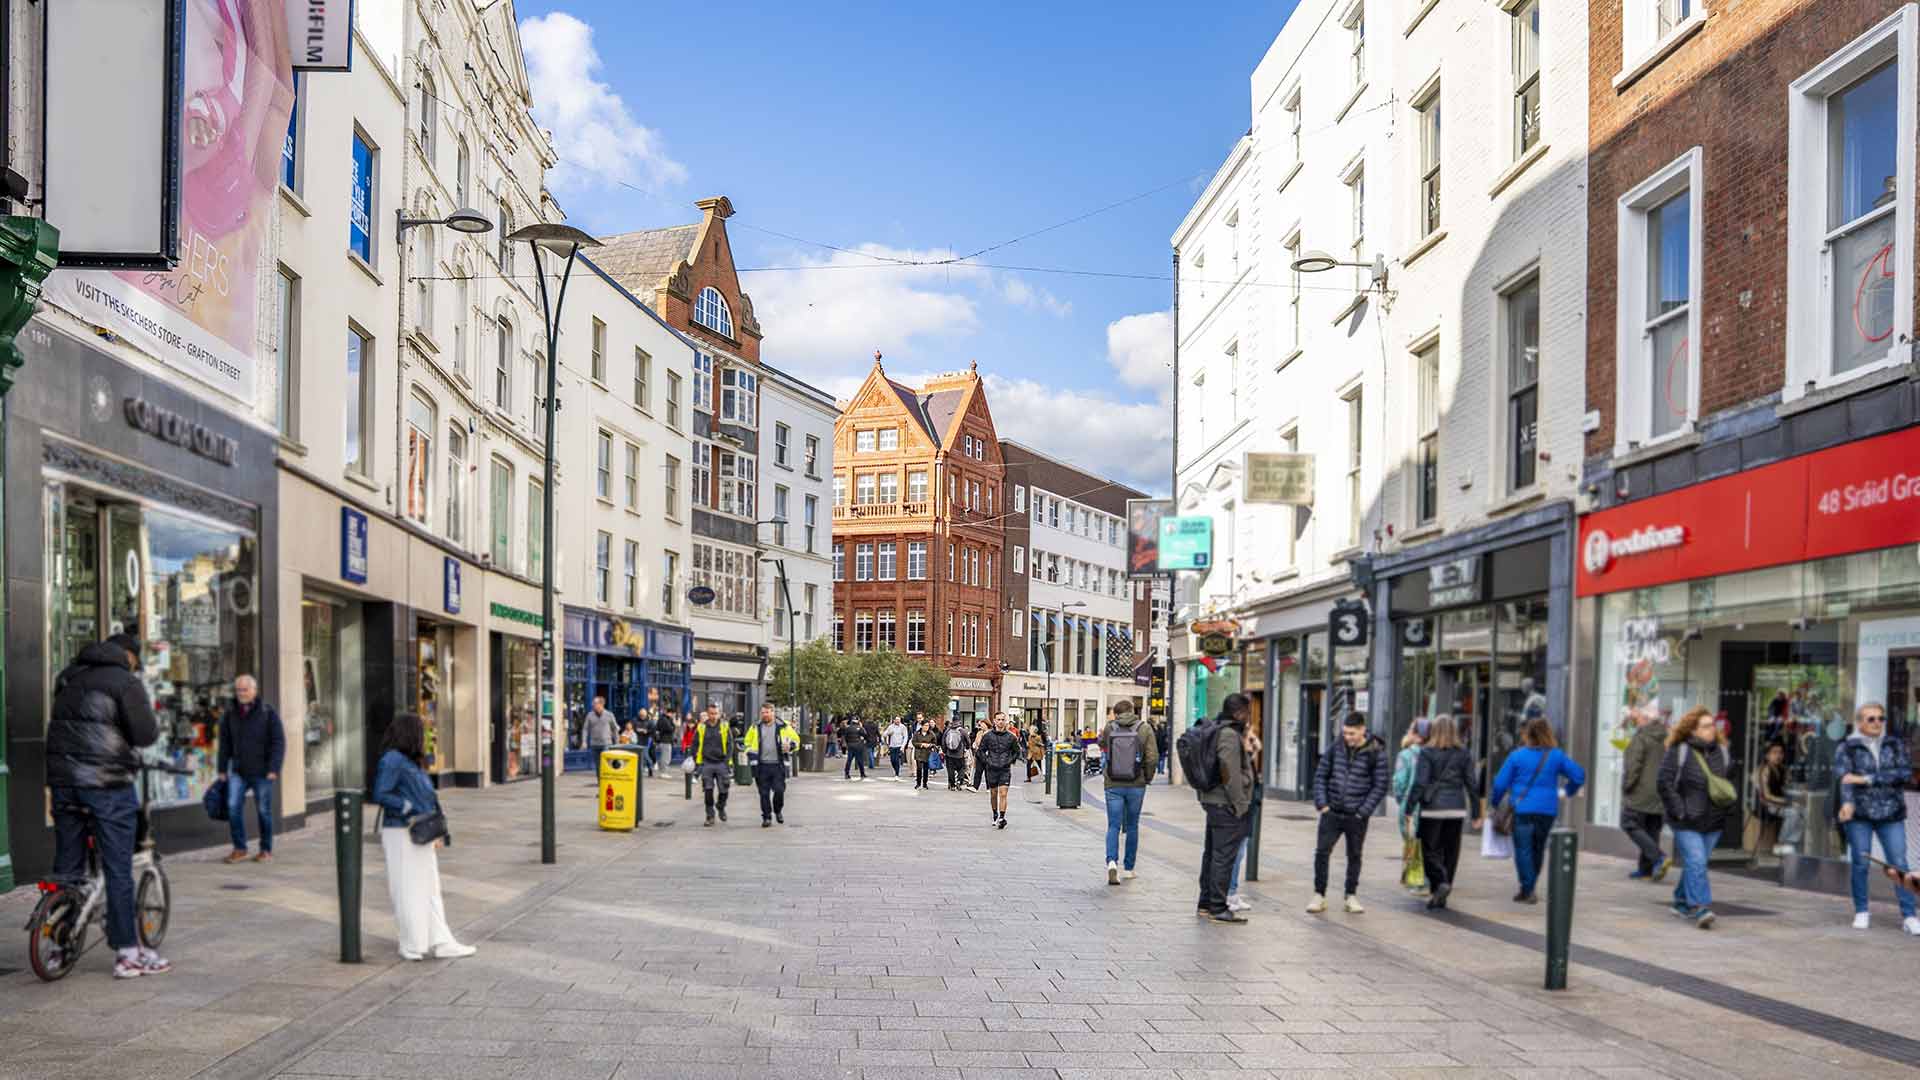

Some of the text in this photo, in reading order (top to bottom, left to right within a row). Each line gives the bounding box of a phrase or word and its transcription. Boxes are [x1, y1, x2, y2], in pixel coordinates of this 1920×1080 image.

[75, 278, 101, 303] VISIT
[102, 292, 120, 313] THE
[120, 303, 158, 337] SKECHERS
[158, 326, 182, 350] STORE
[187, 343, 219, 370] GRAFTON
[219, 360, 241, 381] STREET
[1251, 470, 1307, 483] CIGAR
[1818, 488, 1840, 514] 48
[1843, 477, 1889, 511] Sráid
[1611, 524, 1684, 558] vodafone
[1337, 613, 1360, 642] 3
